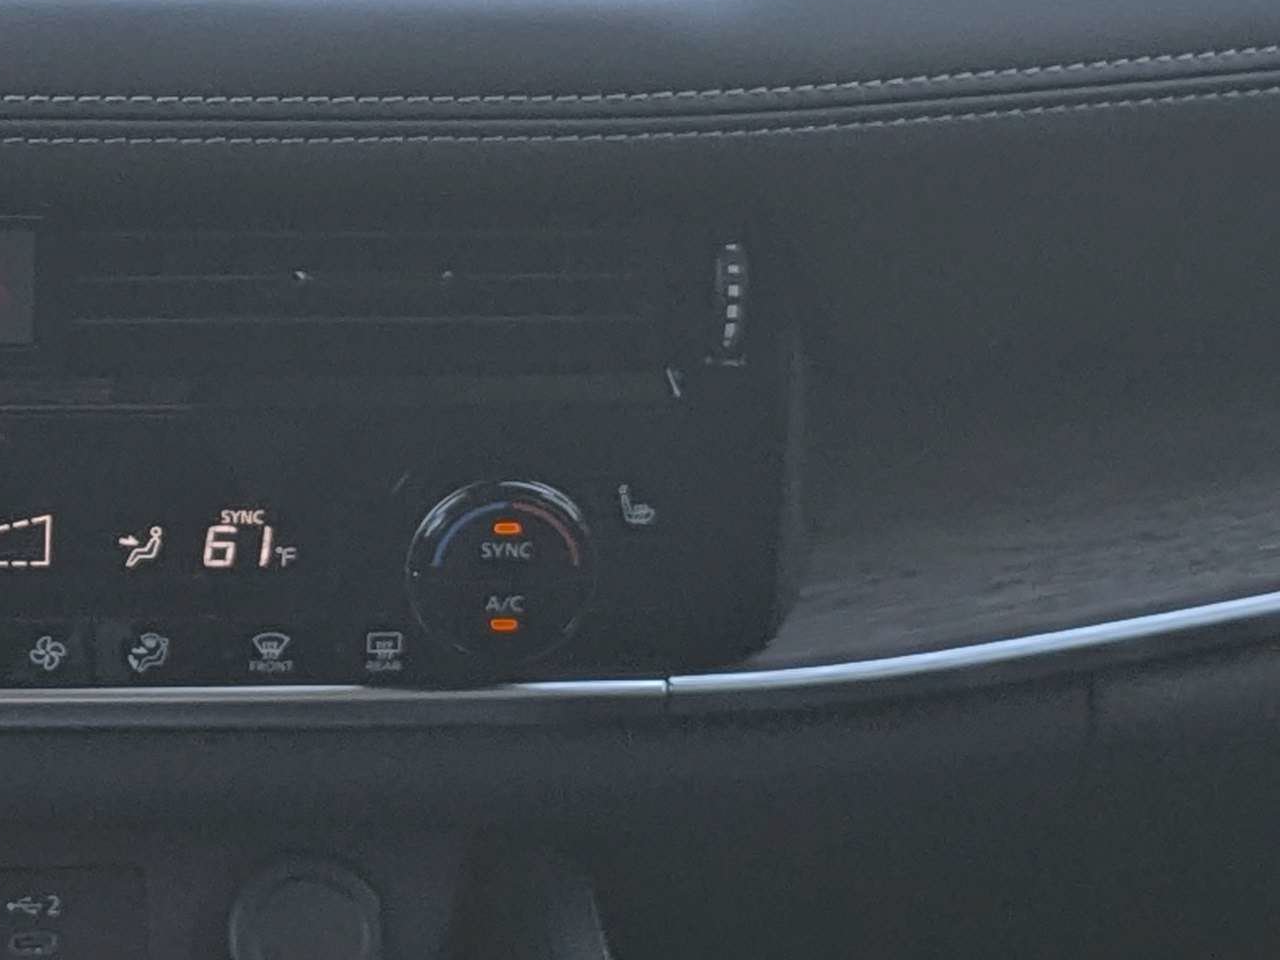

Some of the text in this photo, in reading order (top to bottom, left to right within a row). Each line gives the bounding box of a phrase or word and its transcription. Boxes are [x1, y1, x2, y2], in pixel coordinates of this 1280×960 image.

[220, 509, 265, 525] SYNC
[480, 542, 533, 558] SYNC
[485, 595, 524, 611] A/C
[46, 895, 61, 916] 2
